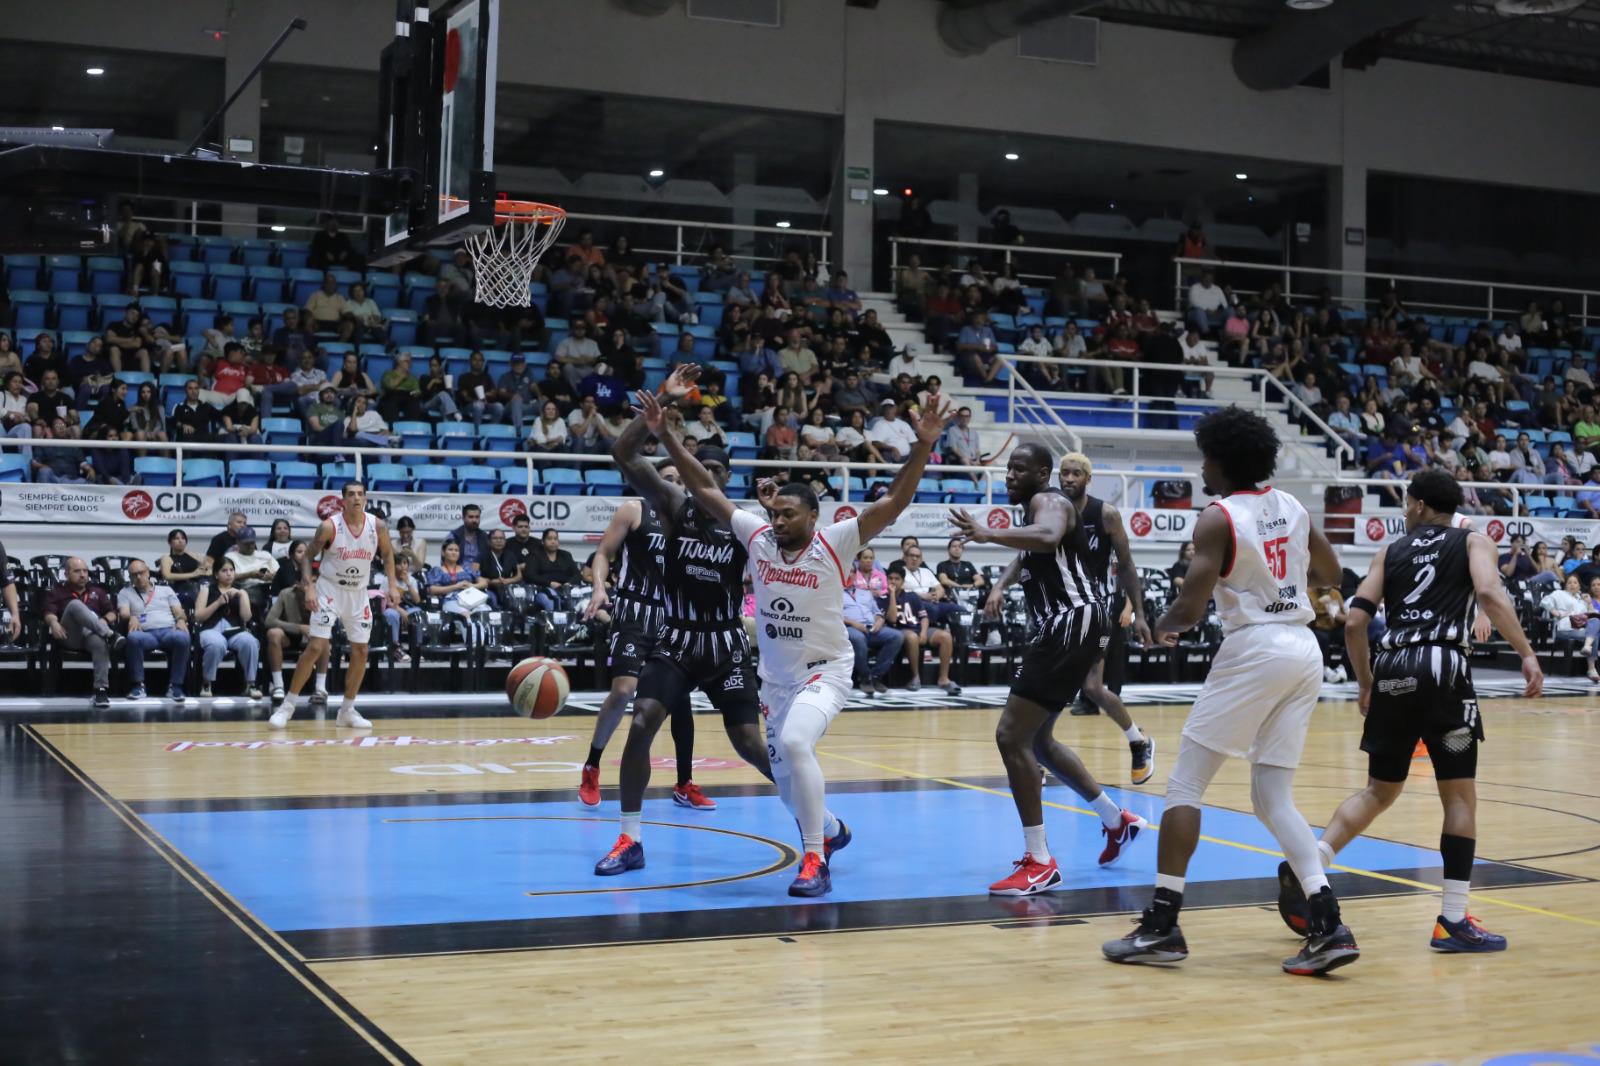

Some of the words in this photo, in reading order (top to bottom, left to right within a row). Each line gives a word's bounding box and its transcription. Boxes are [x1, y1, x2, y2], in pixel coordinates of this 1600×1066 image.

[596, 382, 612, 398] LA
[18, 493, 59, 502] SIEMPRE
[60, 494, 106, 503] GRANDES
[155, 492, 203, 513] CID
[218, 498, 257, 506] SIEMPRE
[258, 498, 302, 508] GRANDES
[25, 503, 65, 512] SIEMPRE
[67, 504, 99, 513] LOBOS
[224, 507, 263, 516] SIEMPRE
[264, 507, 296, 517] LOBOS
[529, 501, 571, 521] CID
[1154, 513, 1186, 532] CID
[1386, 518, 1407, 535] UA
[1506, 521, 1534, 538] CID
[677, 536, 735, 564] TIJUANA
[1263, 536, 1289, 580] 55
[1402, 563, 1436, 605] 2
[780, 613, 811, 623] Azteca
[896, 602, 918, 625] 54
[778, 626, 803, 639] UAD
[723, 675, 744, 688] abc
[388, 761, 586, 776] CID
